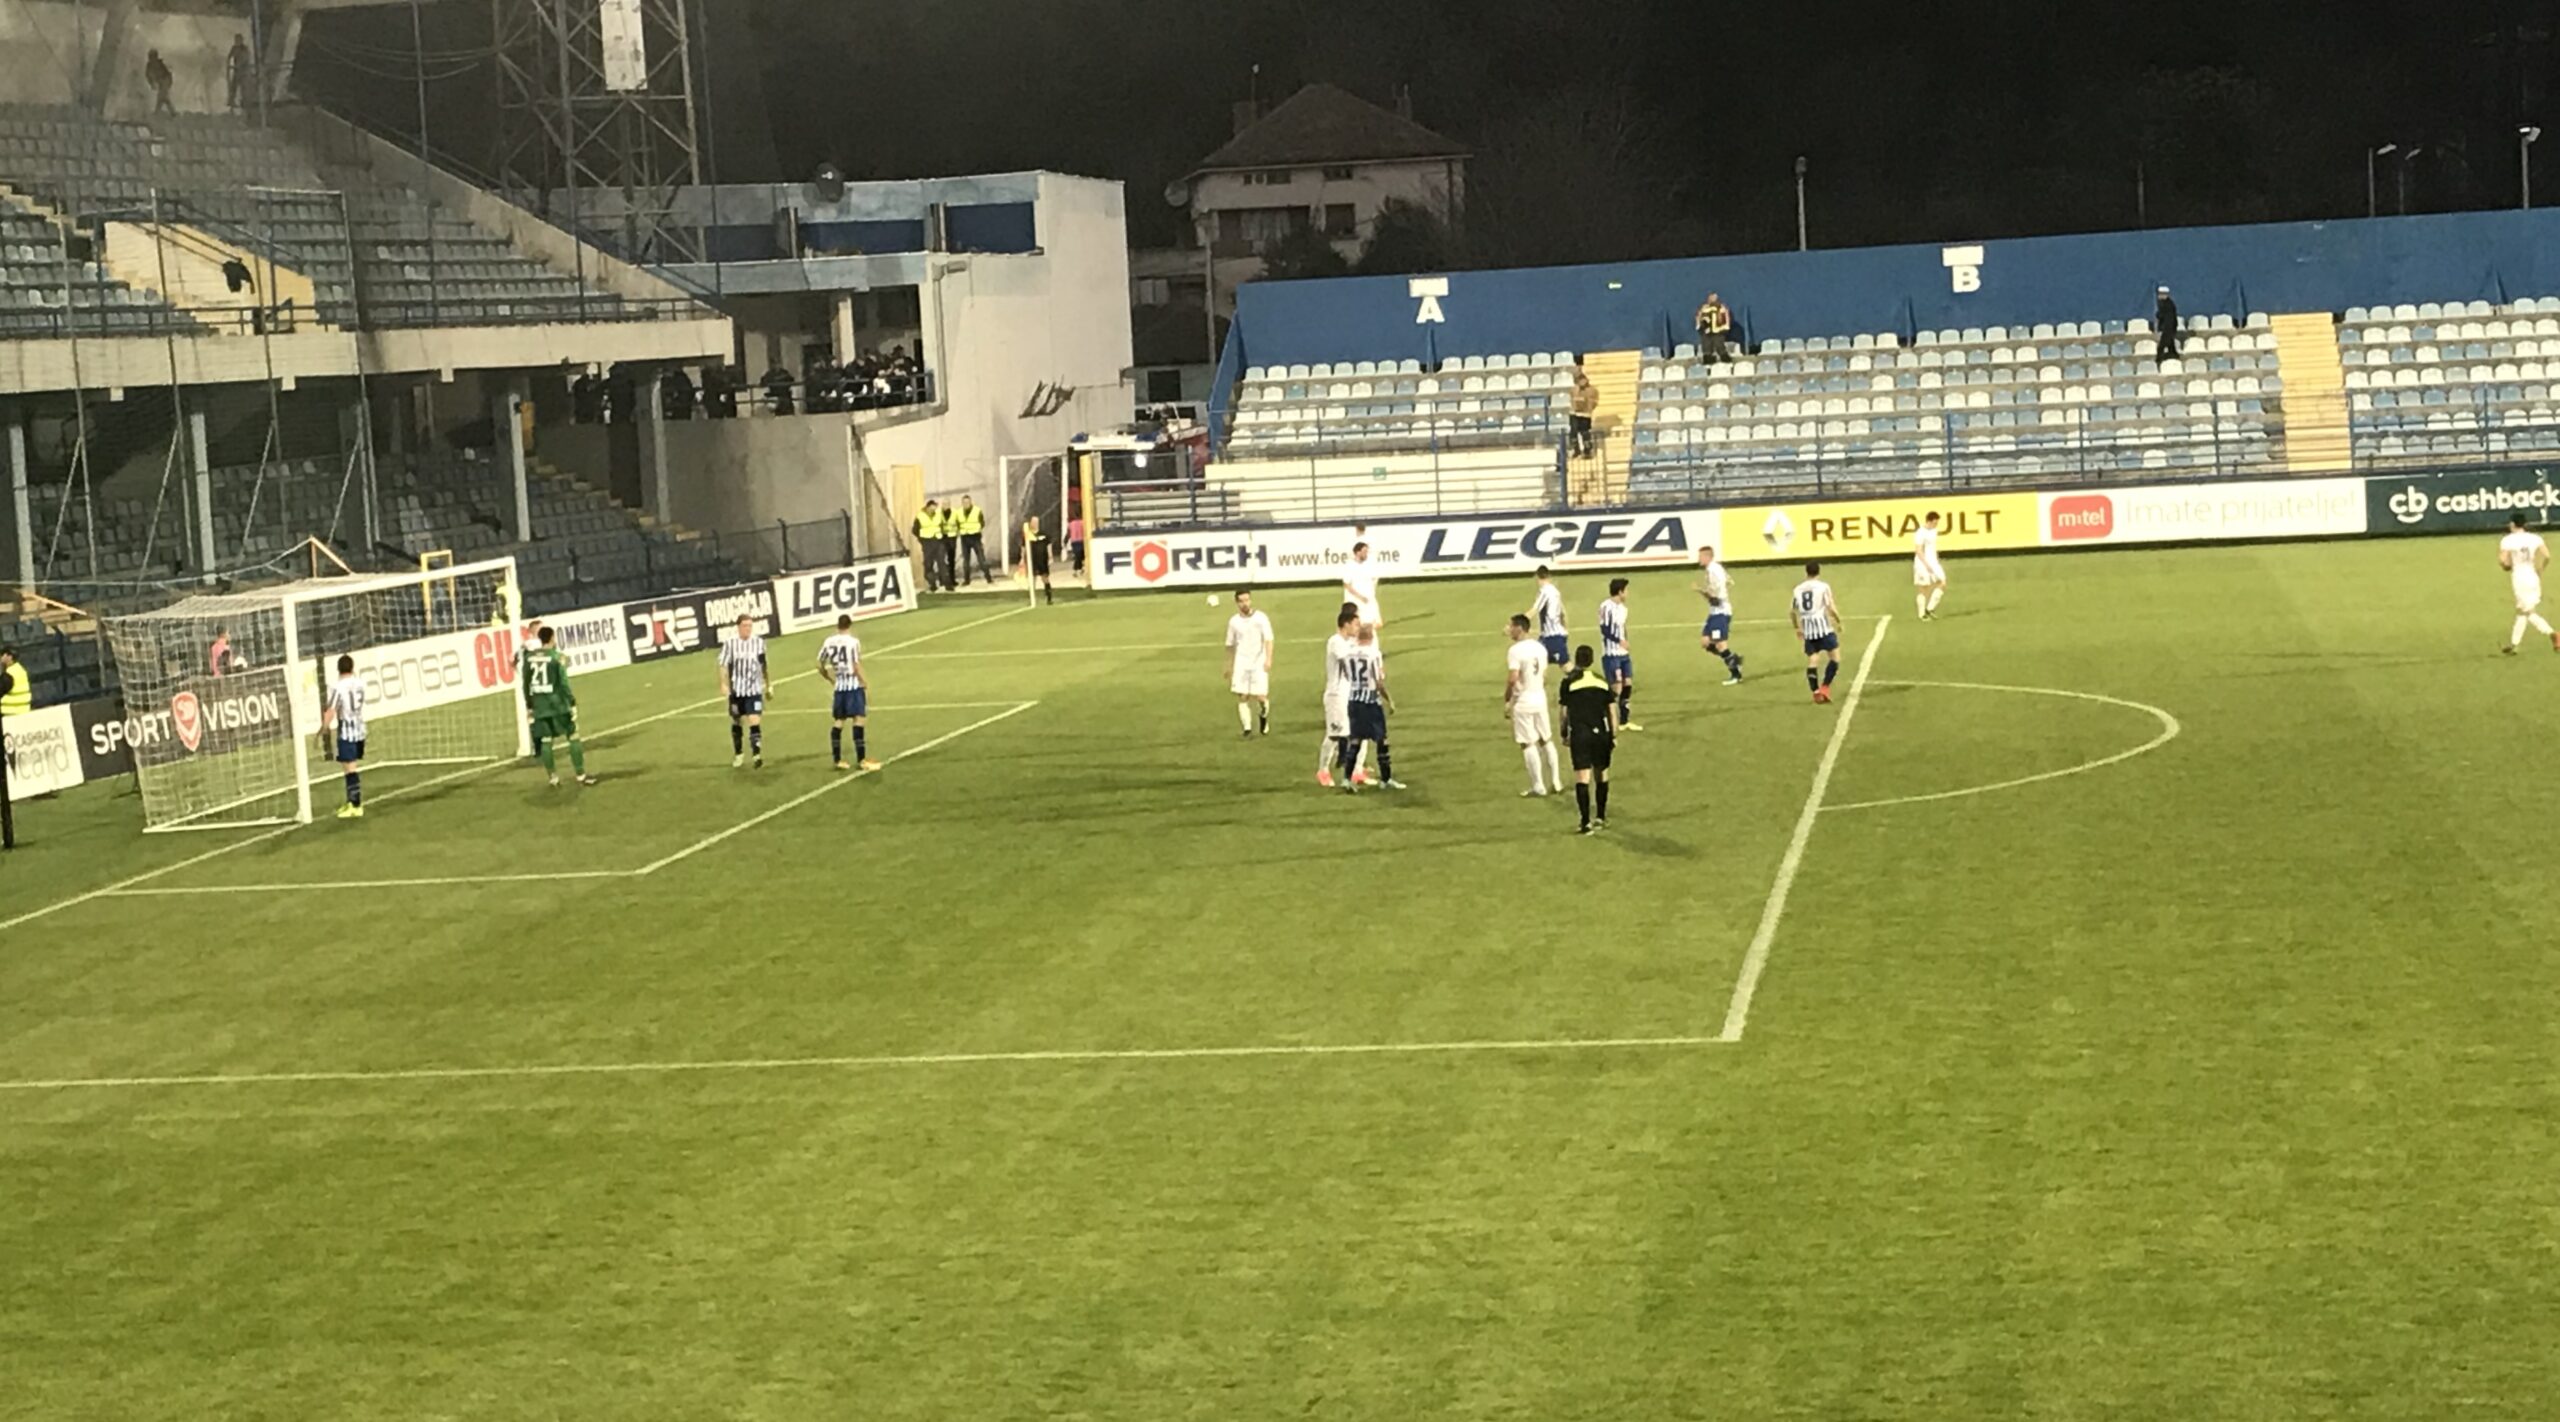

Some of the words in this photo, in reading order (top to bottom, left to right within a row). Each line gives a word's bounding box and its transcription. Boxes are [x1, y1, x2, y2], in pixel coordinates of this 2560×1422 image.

[1952, 265, 1981, 293] B
[1415, 296, 1445, 324] A
[2389, 485, 2429, 514] cb
[2435, 483, 2560, 513] cashback
[1810, 509, 2001, 542] RENAULT
[1420, 517, 1689, 564] LEGEA
[792, 565, 903, 619] LEGEA
[1801, 590, 1814, 612] 8
[555, 617, 617, 652] OMMERCE
[829, 645, 849, 666] 24
[1349, 657, 1369, 682] 12
[529, 661, 549, 686] 21
[91, 710, 171, 755] SPORT
[201, 692, 279, 731] VISION
